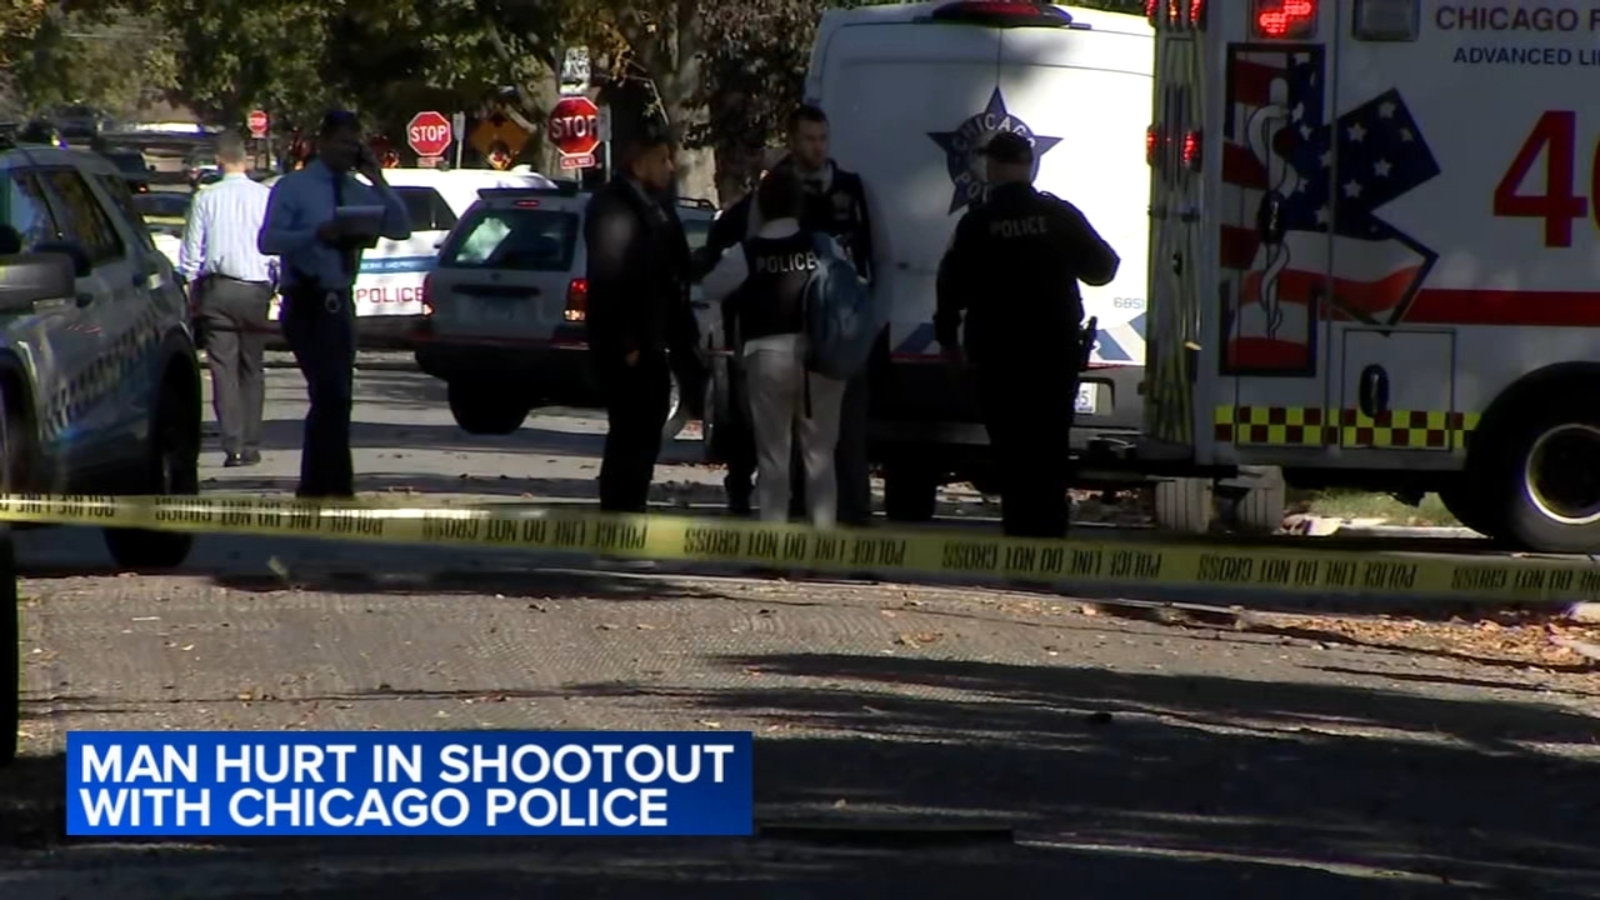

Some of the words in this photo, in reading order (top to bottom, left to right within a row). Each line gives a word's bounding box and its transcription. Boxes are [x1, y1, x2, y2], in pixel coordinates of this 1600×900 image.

[1435, 6, 1579, 31] CHICAGO
[1453, 48, 1571, 66] ADVANCED
[1579, 50, 1600, 66] LI
[410, 125, 447, 142] STOP
[1493, 110, 1600, 248] 4
[990, 215, 1048, 238] POLICE
[757, 252, 816, 273] POLICE
[356, 287, 425, 304] POLICE
[485, 519, 516, 541] NOT
[523, 519, 546, 542] DO
[594, 520, 648, 549] POLICE
[683, 528, 740, 555] CROSS
[748, 530, 778, 558] NOT
[784, 532, 806, 560] DO
[815, 533, 846, 562] LINE
[852, 538, 905, 566] POLICE
[942, 543, 998, 570] CROSS
[1005, 545, 1036, 572] NOT
[1040, 546, 1064, 573] DO
[1071, 548, 1101, 576] LINE
[1110, 550, 1162, 578] POLICE
[1196, 554, 1253, 582] CROSS
[1257, 557, 1291, 585] NOT
[1295, 558, 1318, 586] DO
[1325, 559, 1357, 587] LINE
[1364, 561, 1418, 588] POLICE
[1514, 568, 1546, 589] NOT
[1549, 568, 1574, 591] DO
